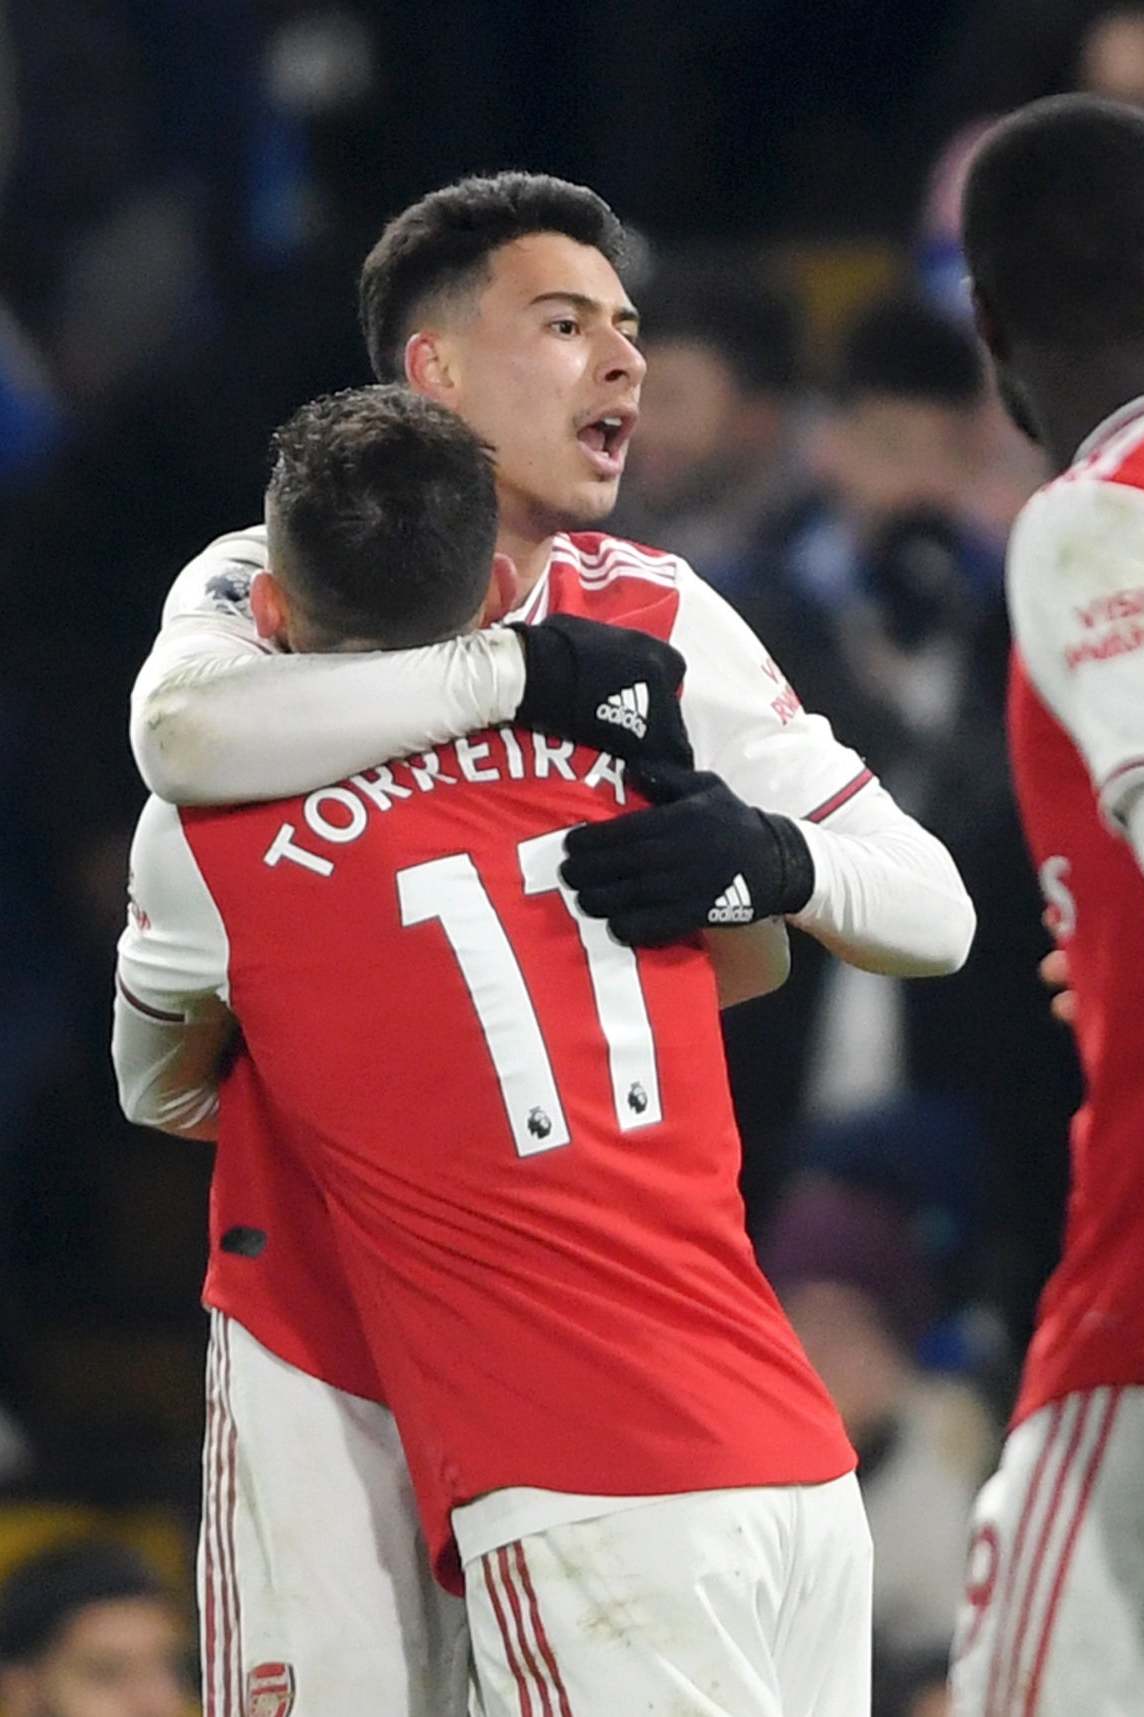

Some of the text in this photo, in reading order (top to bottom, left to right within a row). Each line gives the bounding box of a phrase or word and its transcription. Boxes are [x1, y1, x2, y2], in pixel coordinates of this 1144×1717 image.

[596, 702, 648, 739] adidas
[262, 727, 627, 877] TORREIRA
[395, 821, 664, 1158] 11
